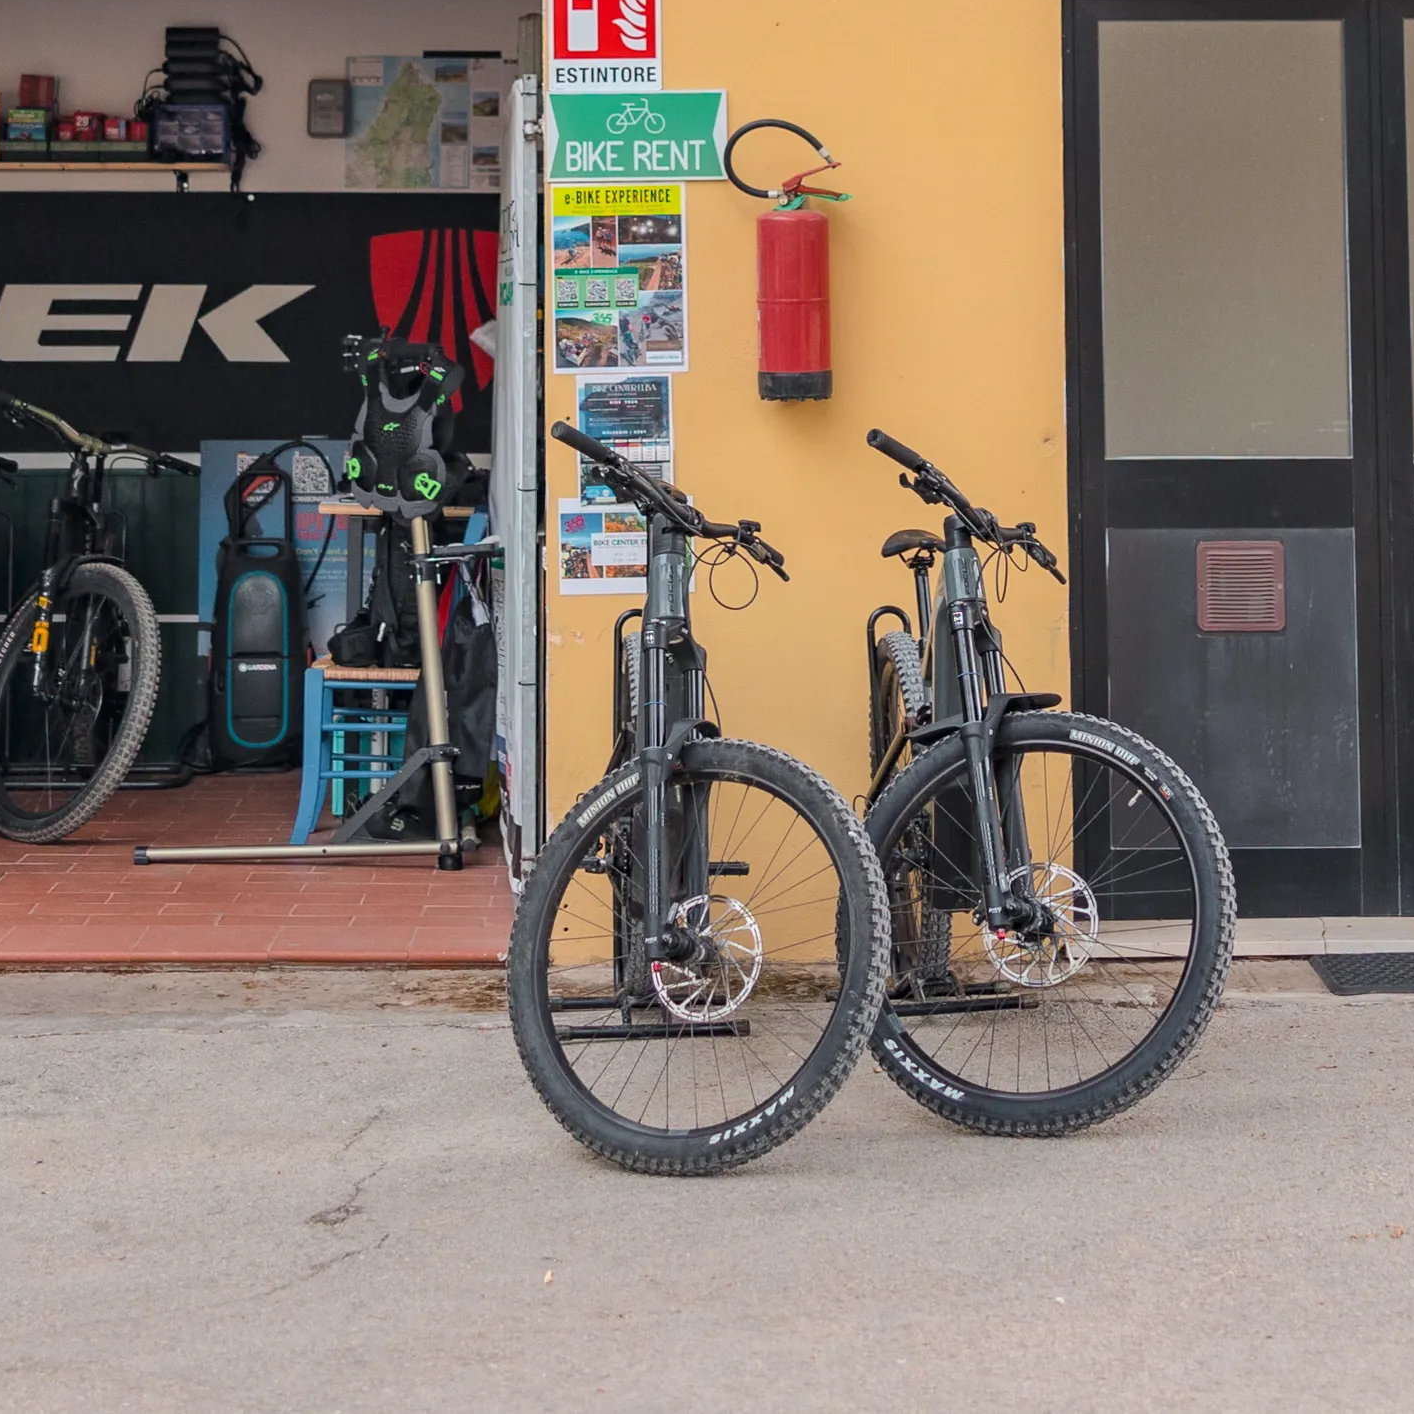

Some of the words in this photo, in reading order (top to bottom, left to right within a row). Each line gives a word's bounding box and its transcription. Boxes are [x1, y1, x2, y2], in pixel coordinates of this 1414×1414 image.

[556, 66, 657, 84] ESTINTORE
[566, 141, 624, 172] BIKE
[634, 140, 705, 172] RENT
[564, 190, 601, 205] e-BIKE
[605, 188, 671, 203] EXPERIENCE
[611, 538, 639, 546] CENTER
[882, 1038, 965, 1101] MAXXIS
[708, 1085, 795, 1145] MAXXIS
